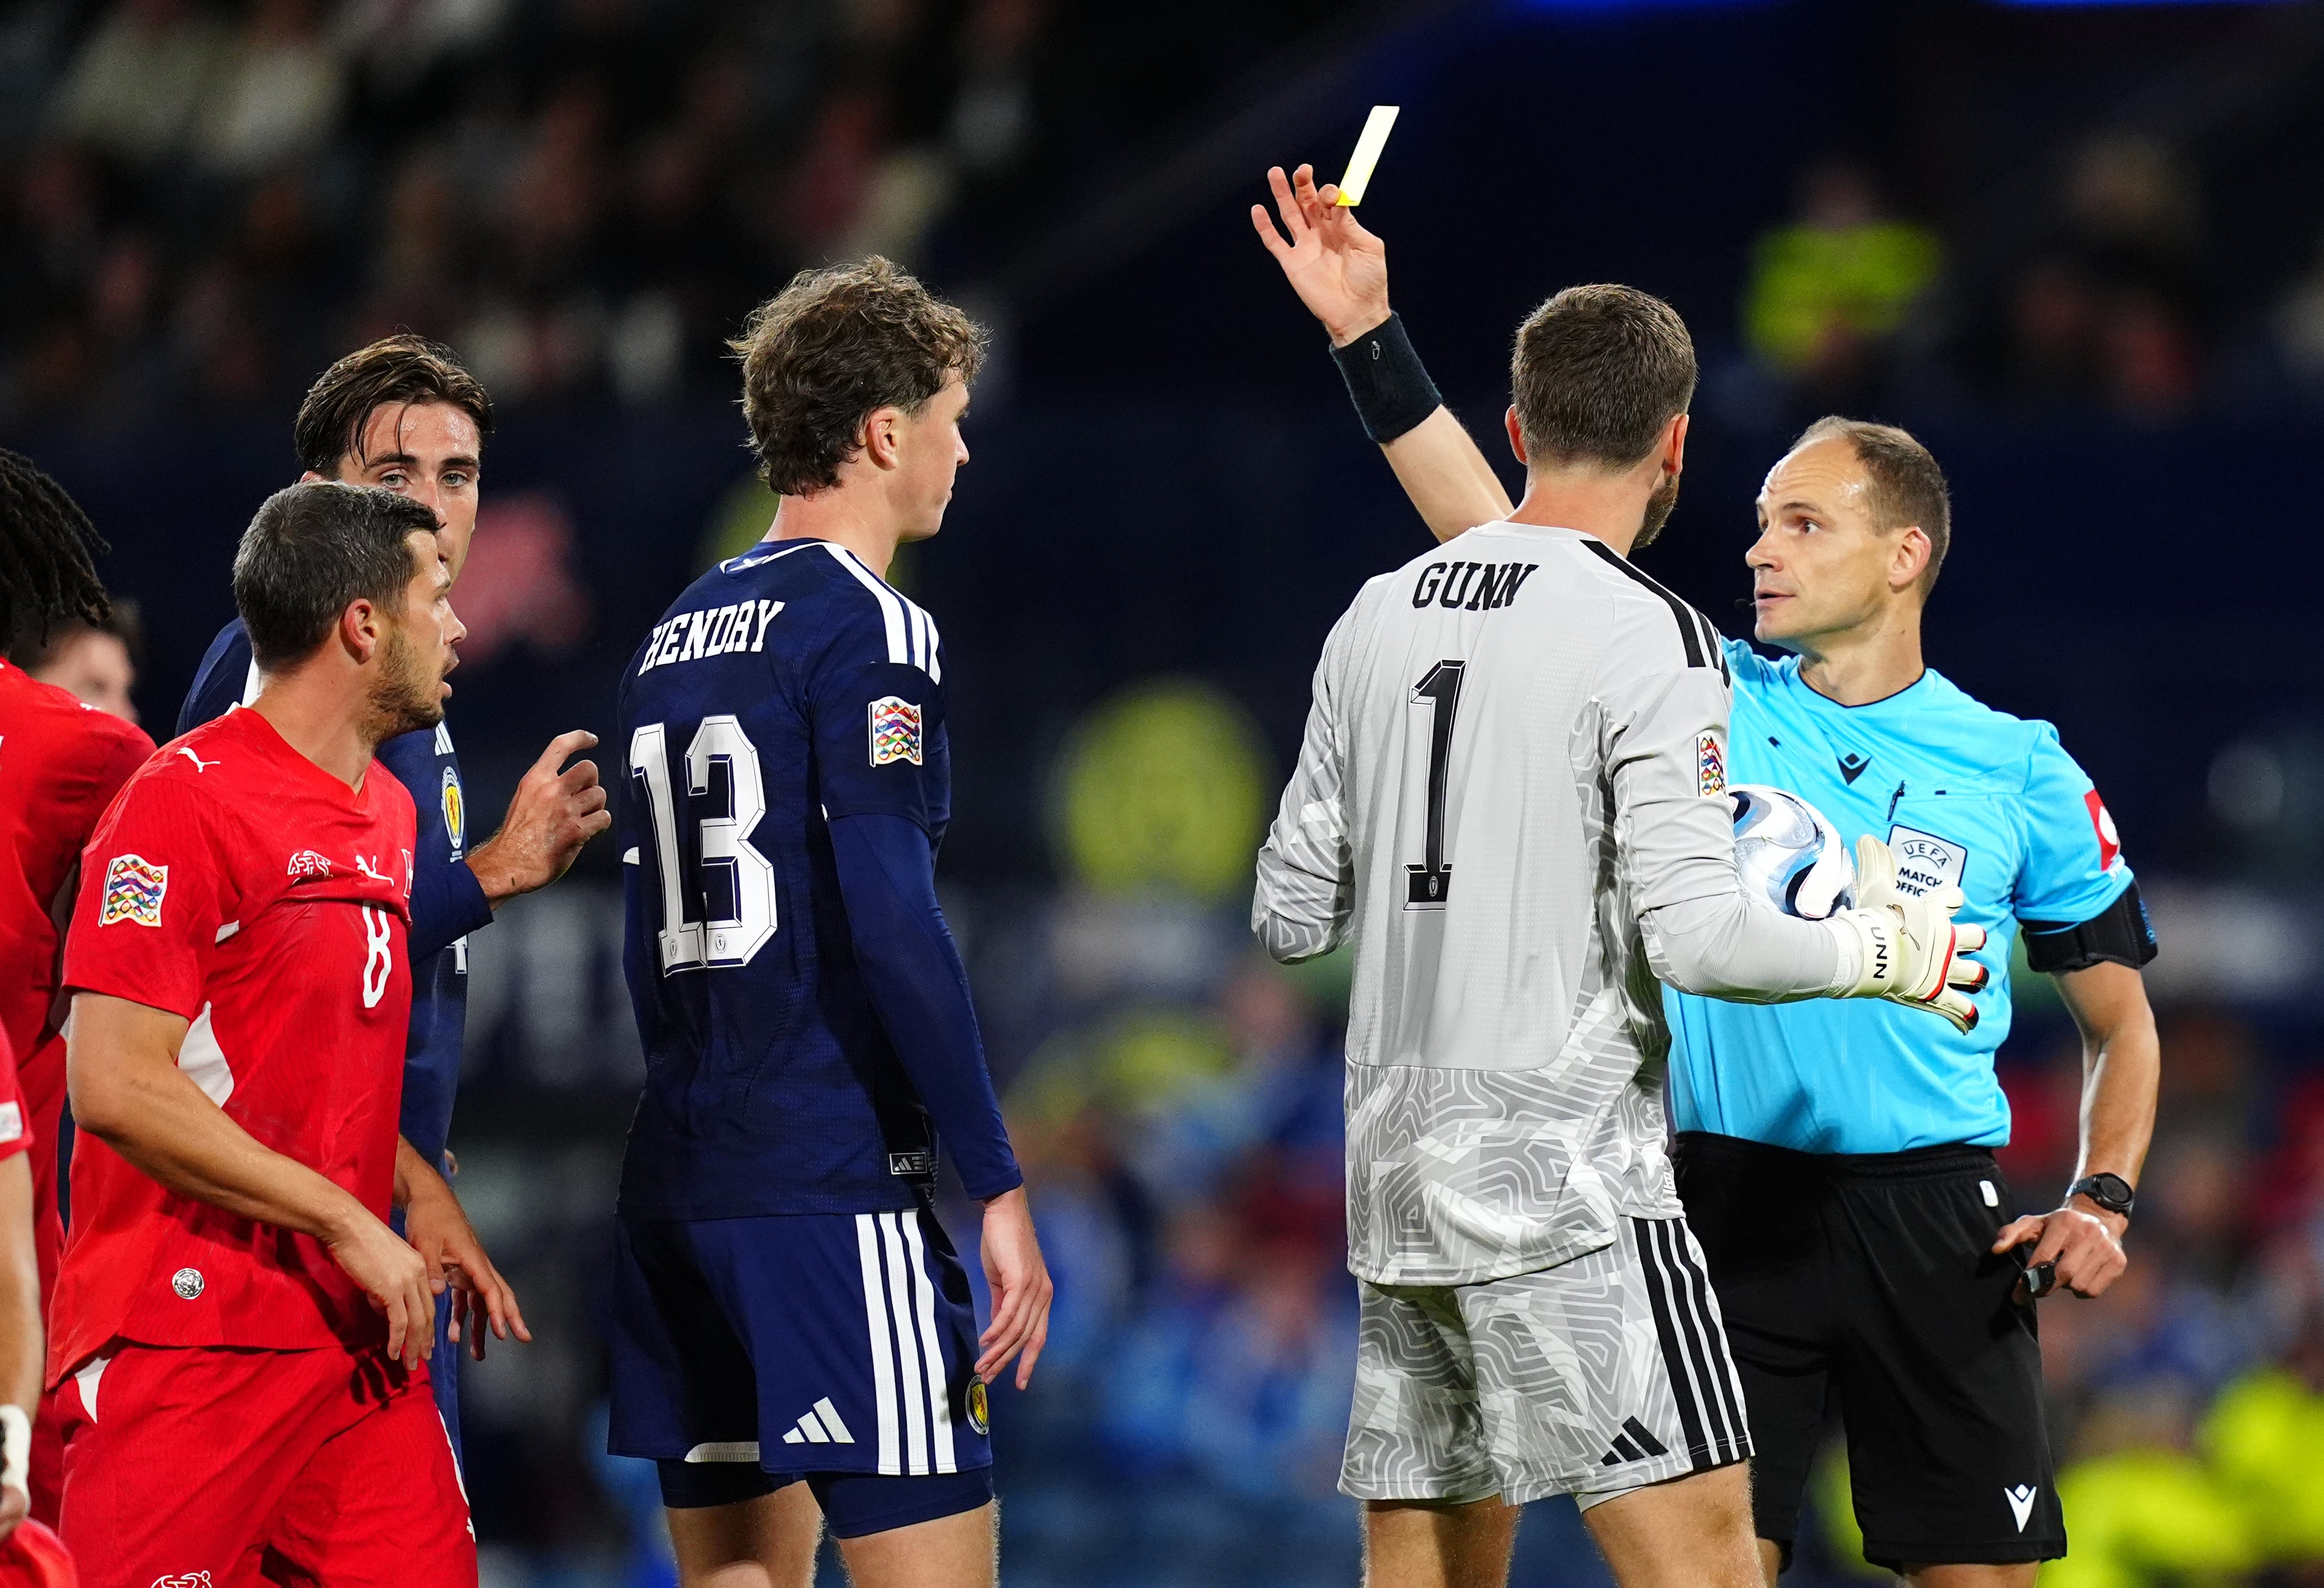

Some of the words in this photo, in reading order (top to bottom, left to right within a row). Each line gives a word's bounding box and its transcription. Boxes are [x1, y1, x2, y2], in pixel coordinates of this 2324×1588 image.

[1412, 561, 1538, 612] GUNN
[637, 599, 785, 676] HENDRY
[1402, 658, 1466, 911] 1
[629, 714, 778, 978] 13
[1899, 867, 1942, 888] MATCH
[1904, 843, 1947, 867] UEFA
[363, 900, 392, 1008] 8
